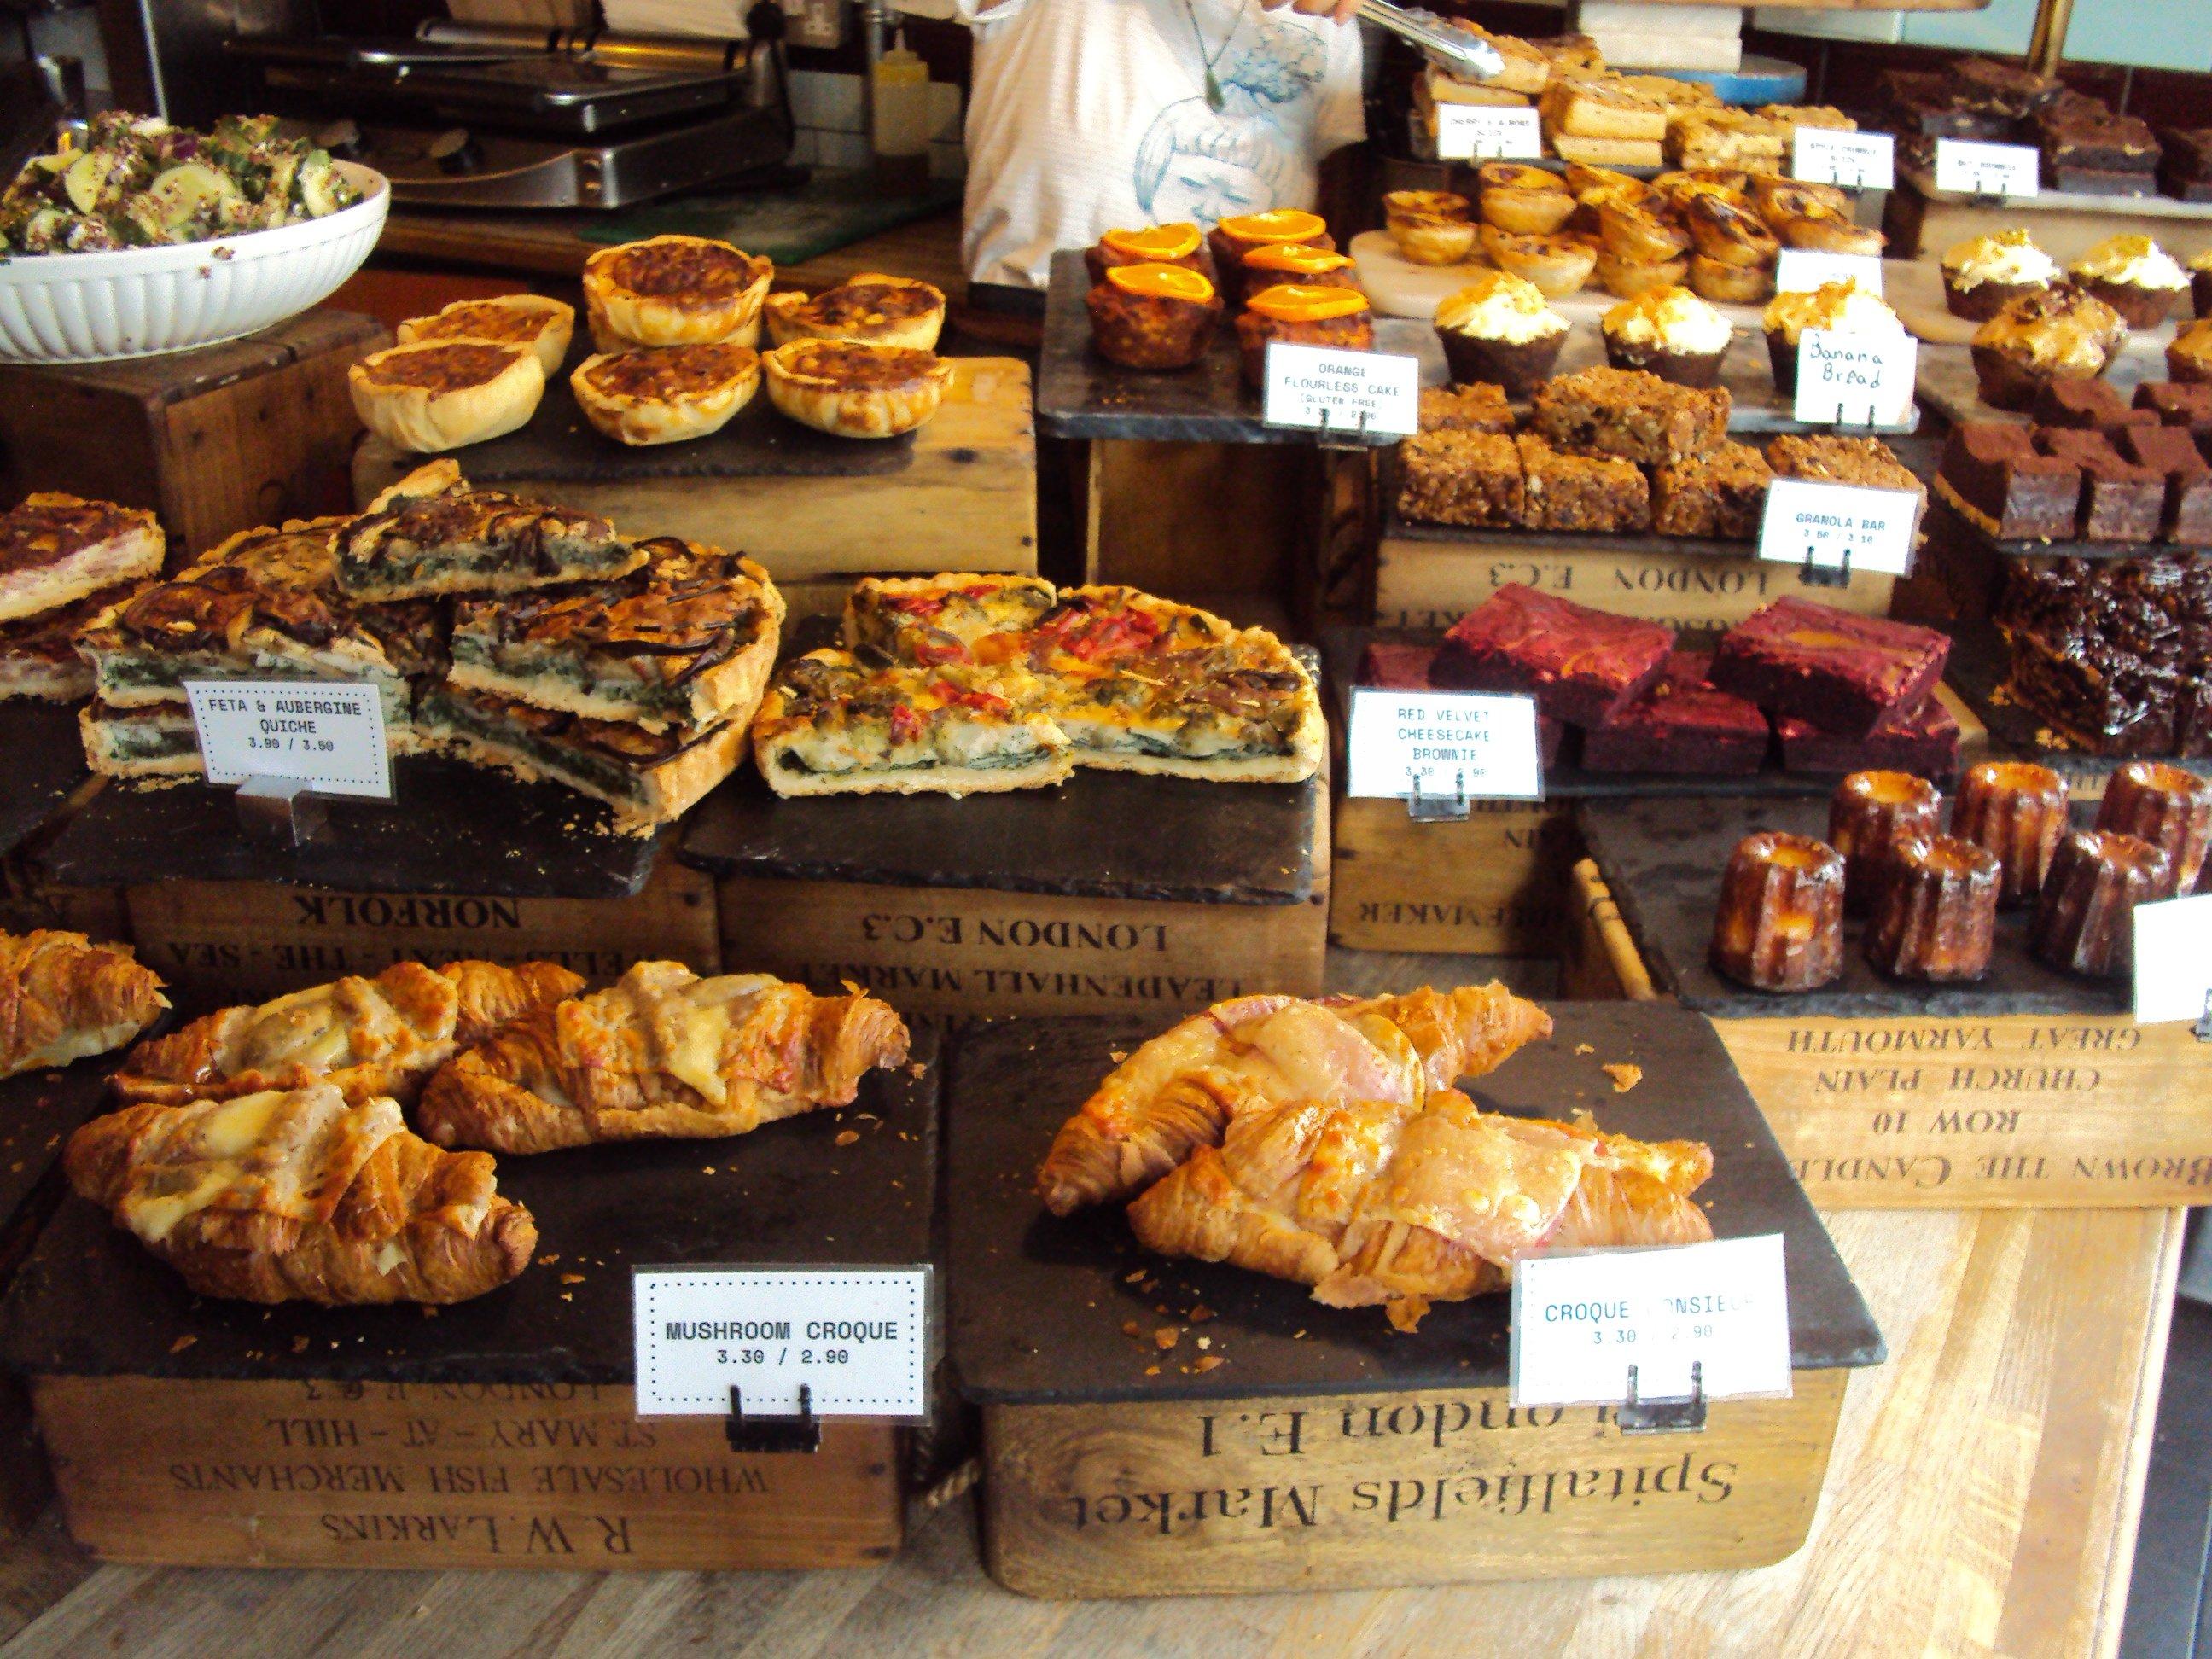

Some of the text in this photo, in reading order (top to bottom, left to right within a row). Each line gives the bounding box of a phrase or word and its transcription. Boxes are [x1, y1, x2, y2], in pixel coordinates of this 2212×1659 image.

[1810, 332, 1883, 364] Banana
[1318, 364, 1367, 377] ORANGE
[1822, 361, 1881, 389] Bread
[1284, 376, 1400, 397] FLOURLESS CAKE
[1796, 512, 1885, 531] GRANOLA BAR
[1615, 568, 1767, 597] LONDON
[208, 698, 363, 716] FETA & AUBERGINE
[1397, 707, 1489, 723] RED VELVET
[259, 719, 317, 735] QUICHE
[1397, 727, 1490, 742] CHEESECAKE
[302, 739, 334, 752] 3.50
[1412, 747, 1477, 761] BROWNIE
[293, 895, 521, 930] NORFOLK
[861, 915, 1167, 952] LONDON E.C.3
[166, 942, 242, 969] SEA
[974, 969, 1242, 1002] LEADENHALL
[1785, 1027, 2143, 1055] GREAT YARMOUTH
[1814, 1068, 2102, 1093] CHURCH PLAIN
[1871, 1109, 2021, 1136] ROW 10
[1975, 1156, 2048, 1180] THE
[2071, 1155, 2212, 1187] BROWN
[1545, 1301, 1630, 1324] CROQUE
[666, 1321, 899, 1343] MUSHROOM CROQUE
[716, 1347, 849, 1366] 3.30 / 2.90
[265, 1418, 360, 1448] HILL
[490, 1419, 597, 1449] MARY
[169, 1463, 769, 1495] WHOLESALE FISH MERCHANTS
[1064, 1452, 1739, 1536] Spitalfields Market
[320, 1514, 502, 1555] LARKINS
[595, 1516, 634, 1555] R
